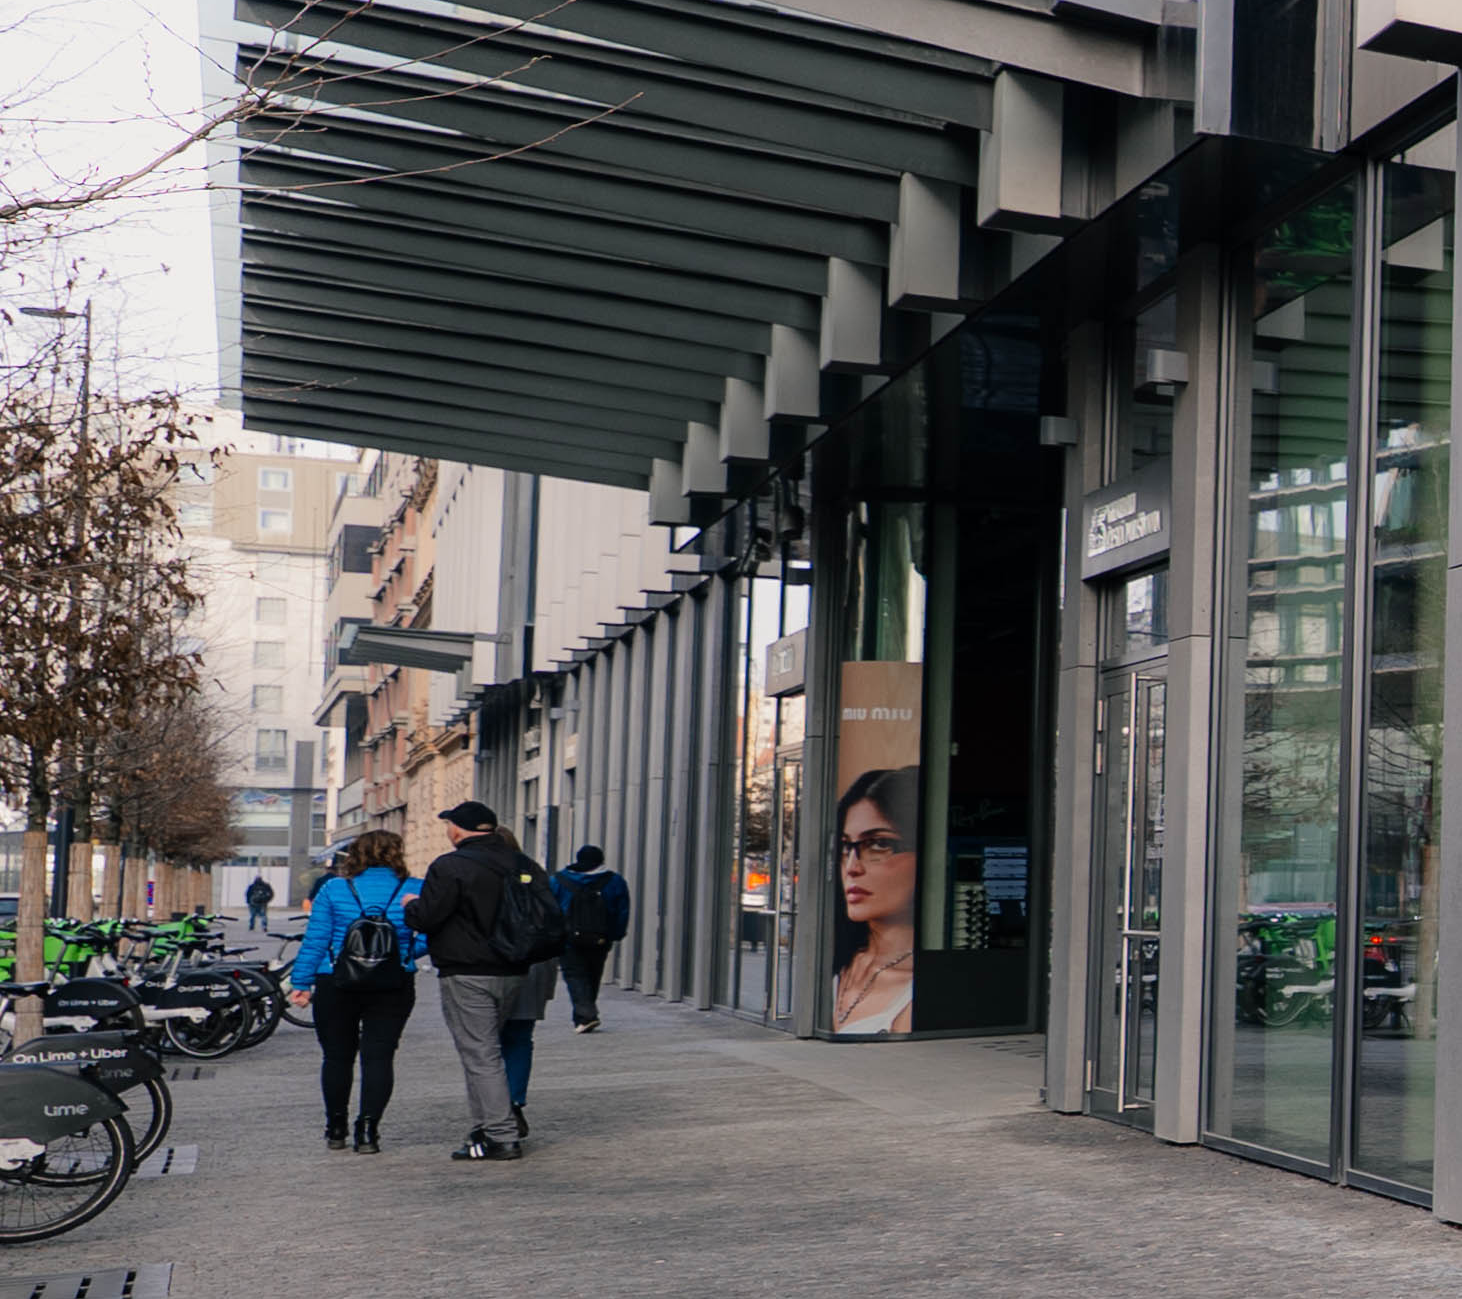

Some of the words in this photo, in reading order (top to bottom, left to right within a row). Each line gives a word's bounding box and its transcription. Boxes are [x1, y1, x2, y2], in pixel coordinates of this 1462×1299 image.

[13, 1053, 38, 1065] On
[39, 1051, 77, 1063] Lime
[90, 1048, 129, 1060] Uber
[44, 1103, 89, 1117] Lime
